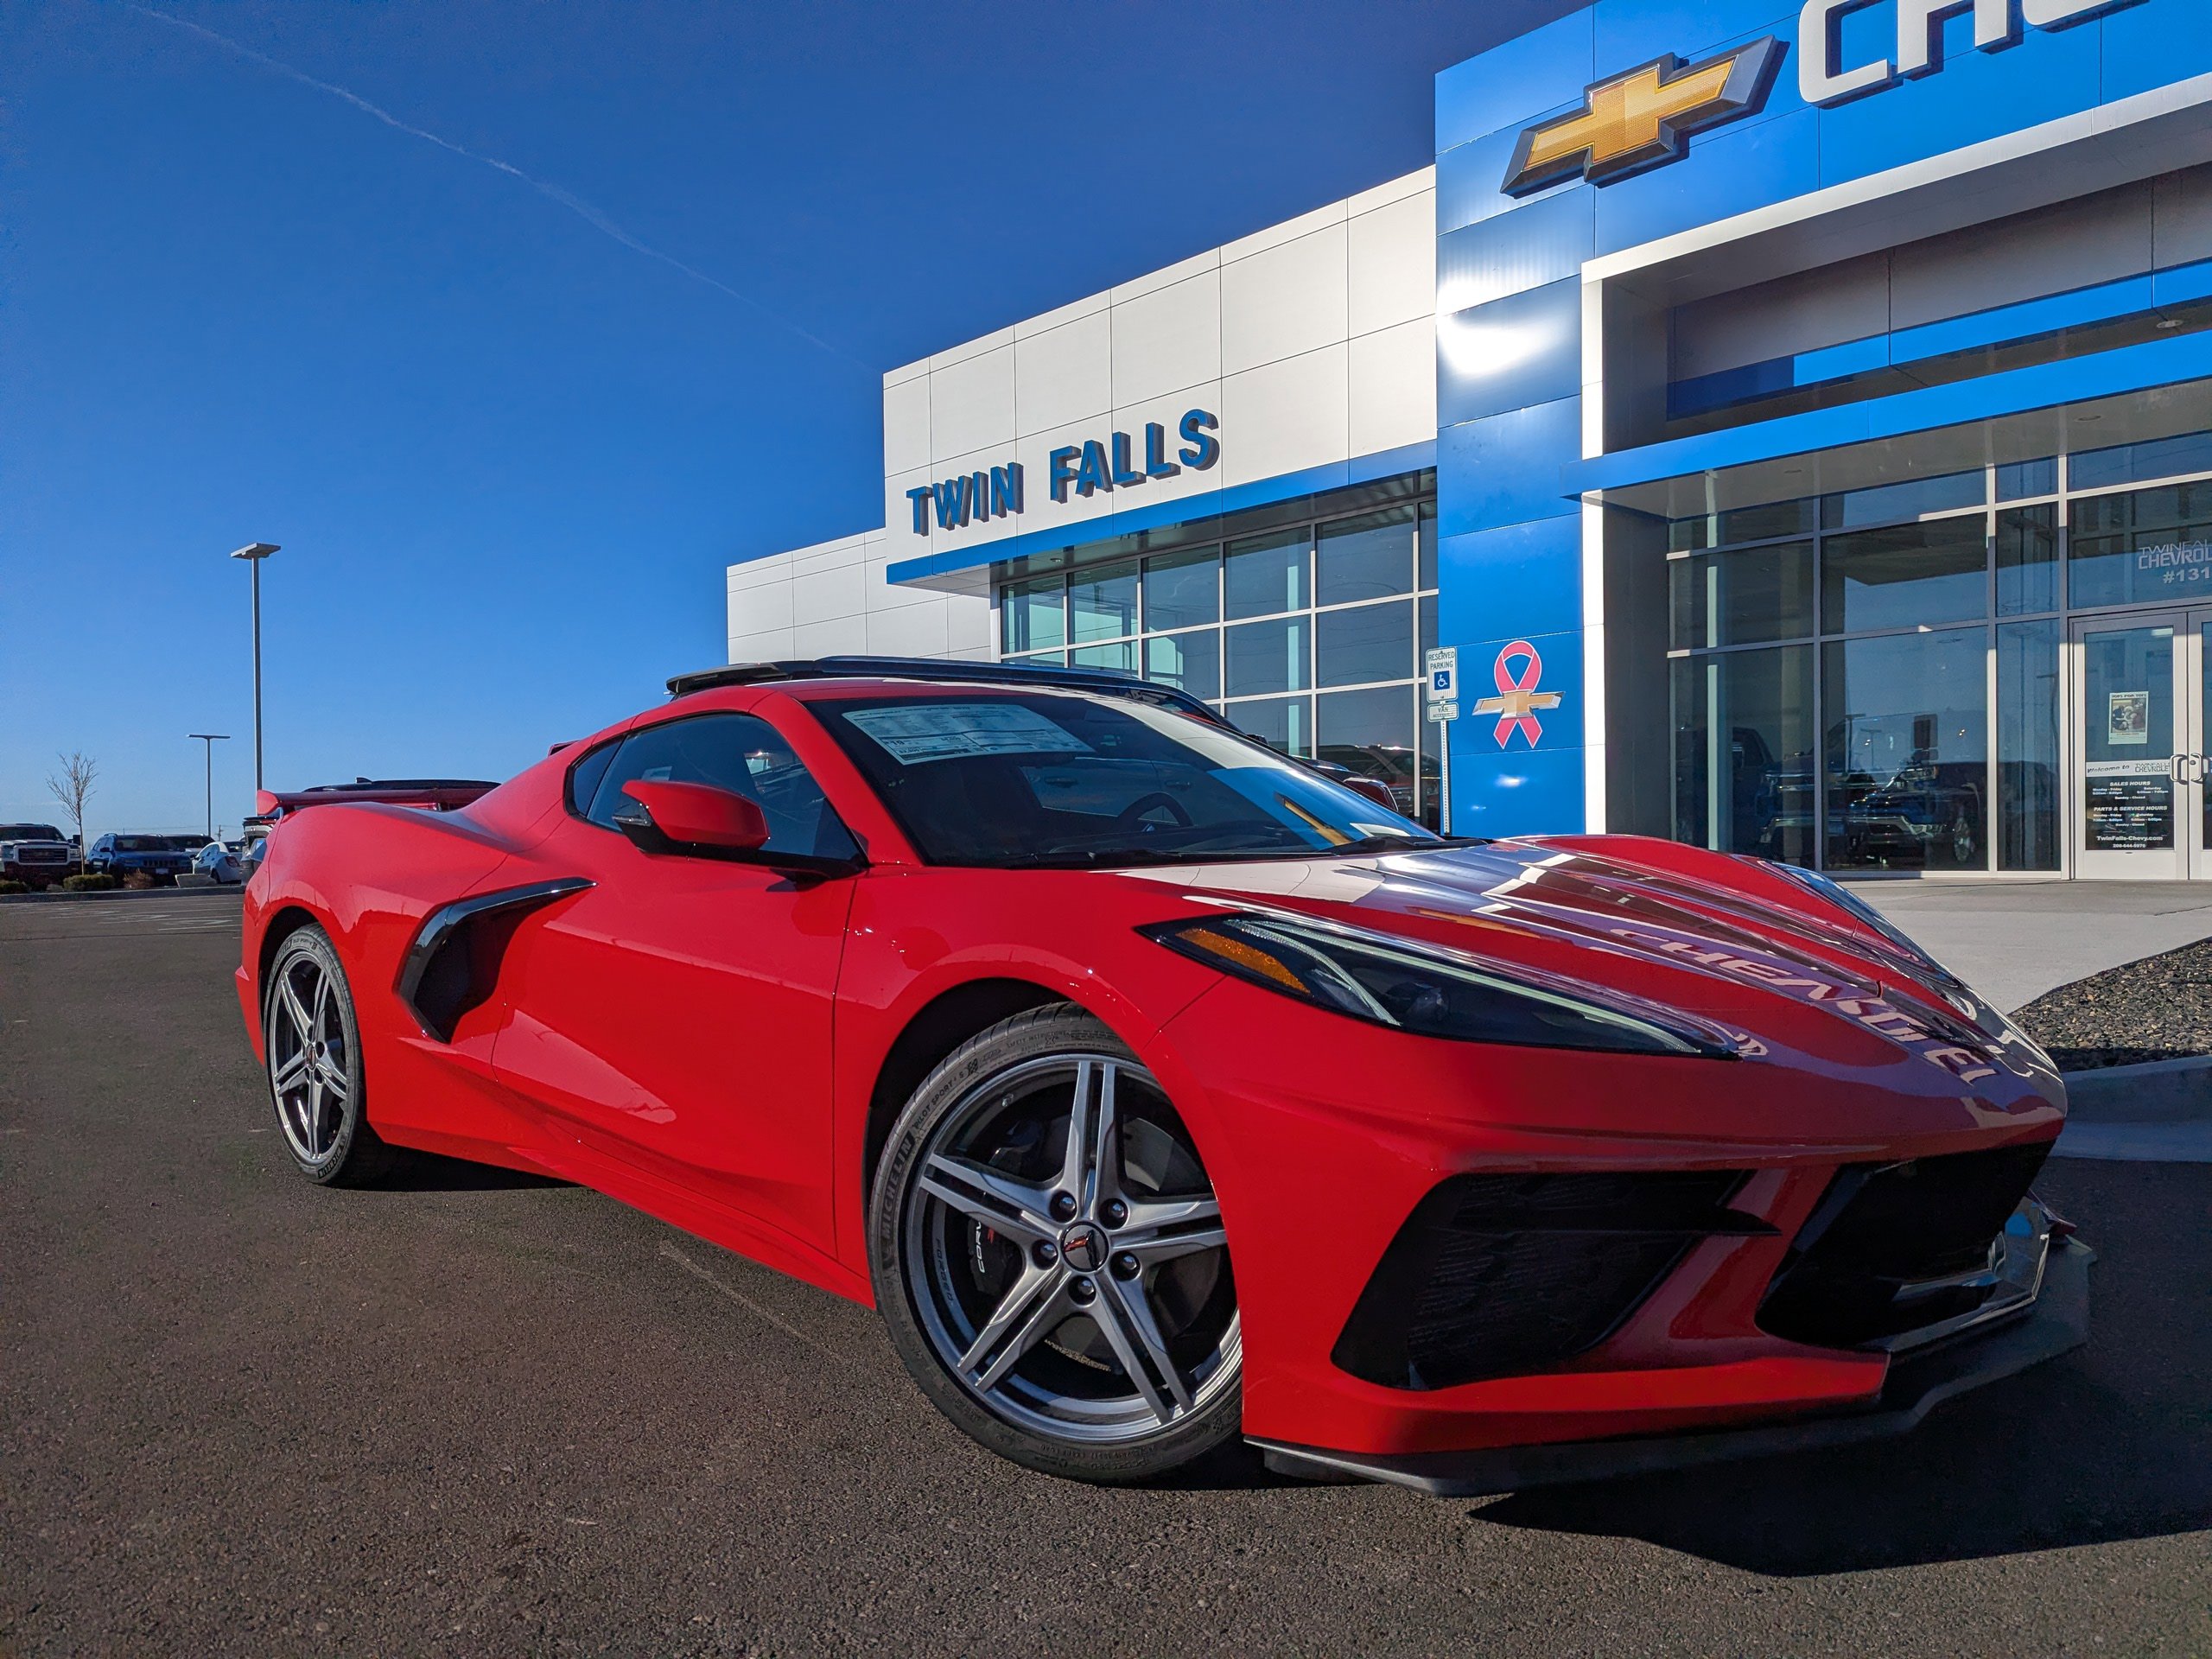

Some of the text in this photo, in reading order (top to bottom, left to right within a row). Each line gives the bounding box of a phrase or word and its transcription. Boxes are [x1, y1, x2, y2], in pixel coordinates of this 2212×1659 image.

[906, 409, 1219, 537] TWIN FALLS
[1428, 651, 1455, 662] RESERVED
[1430, 660, 1453, 670] PARKING
[912, 1078, 954, 1129] PILOT SPORT
[880, 1137, 913, 1241] MICHELIN
